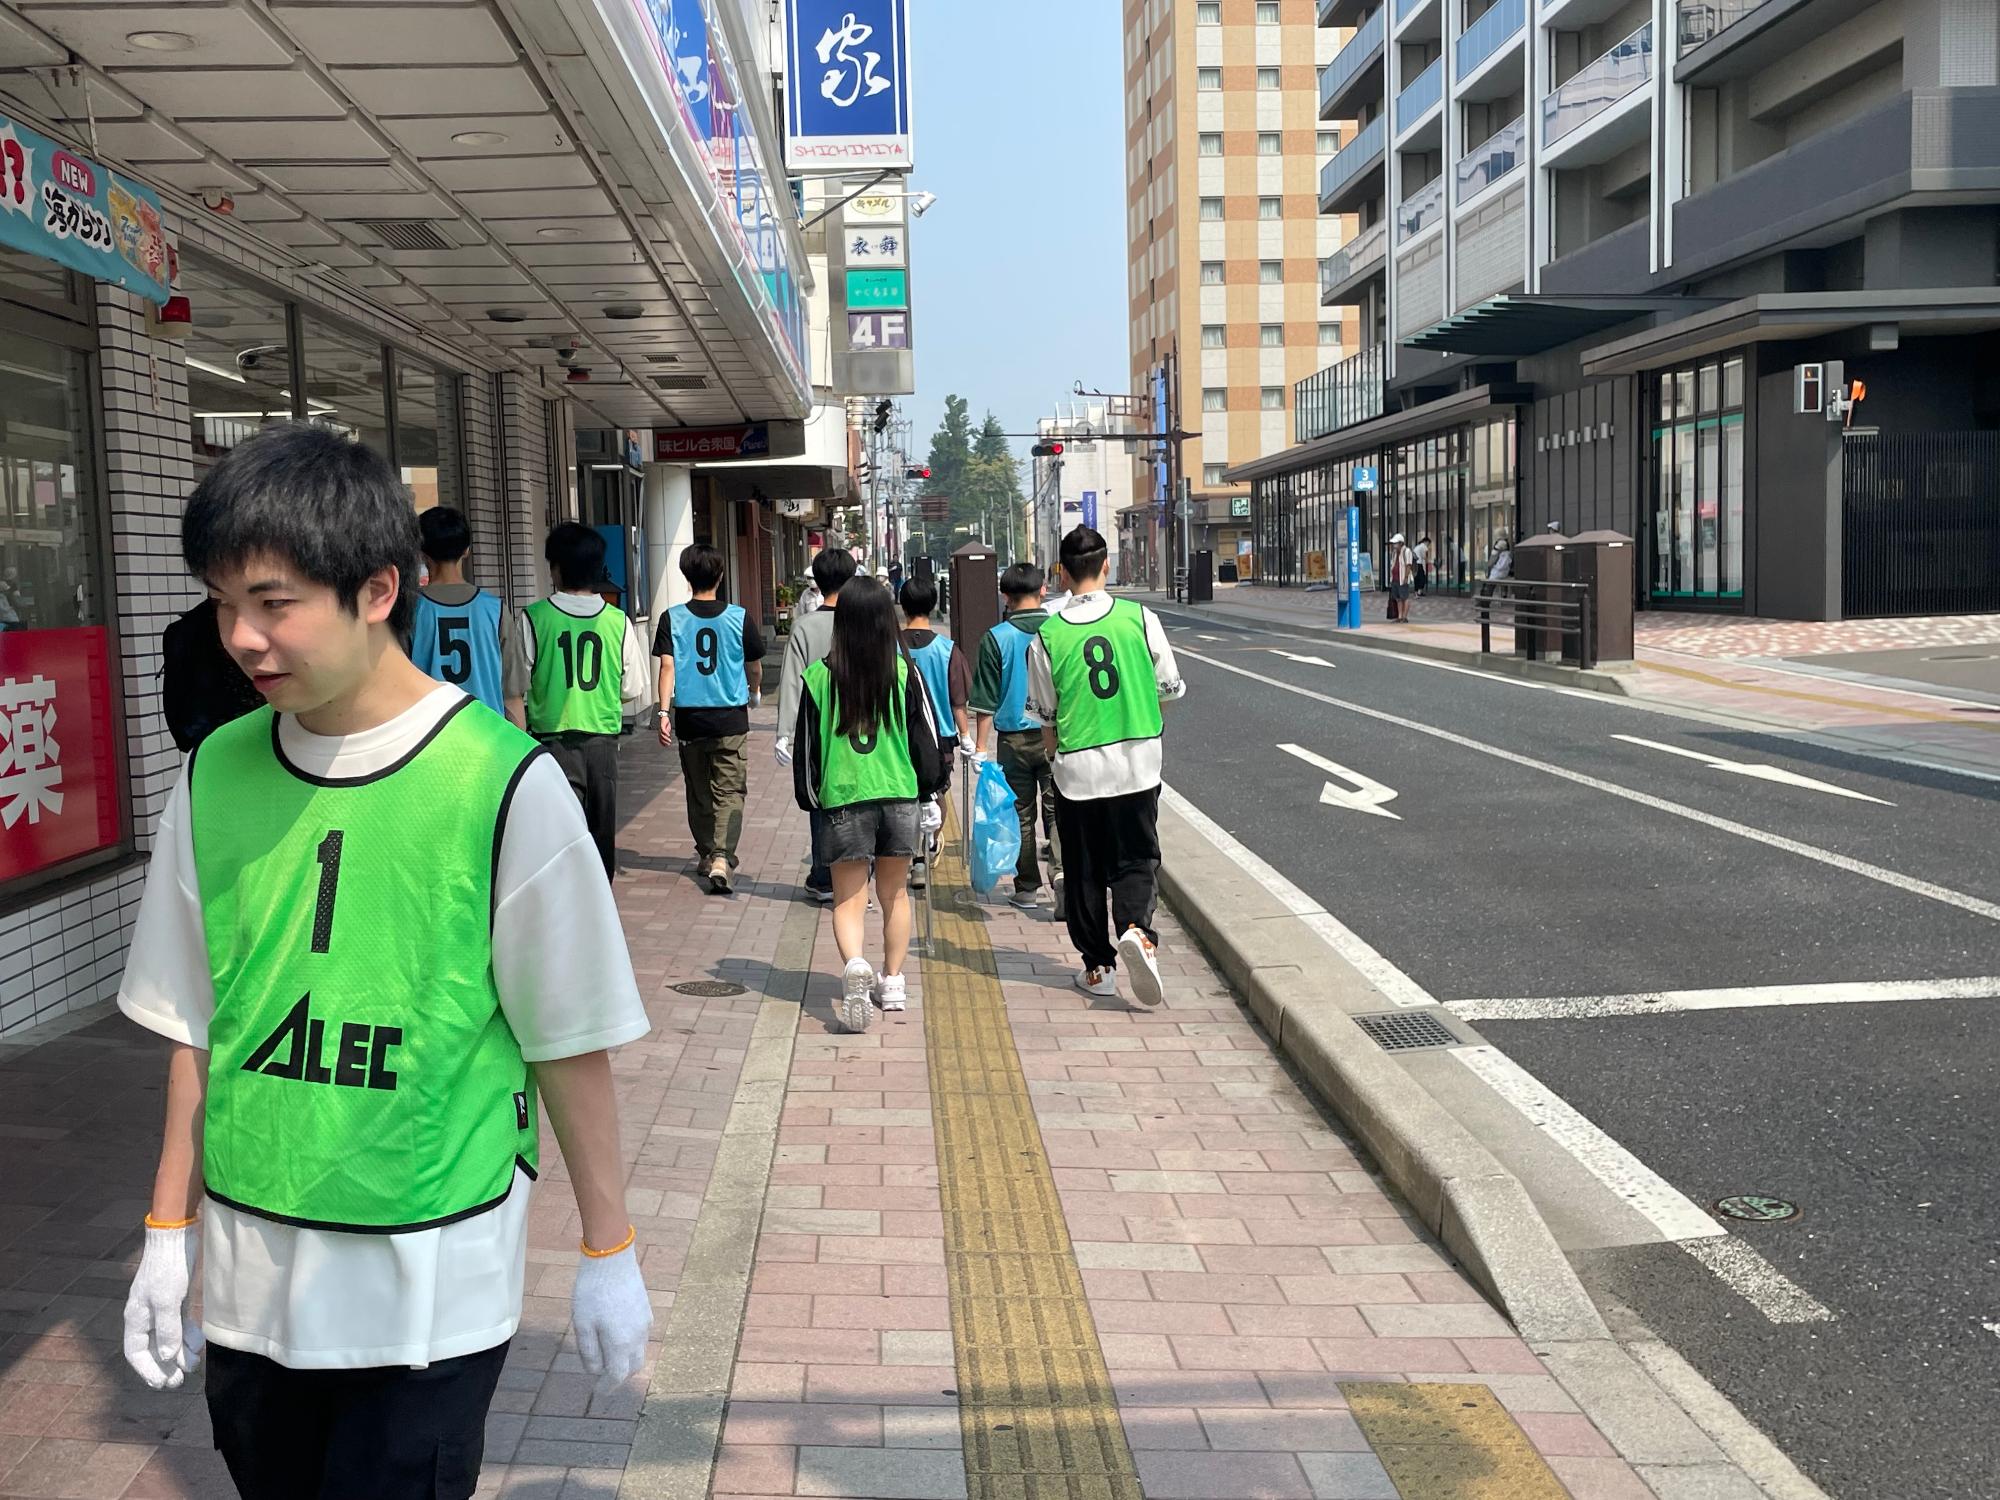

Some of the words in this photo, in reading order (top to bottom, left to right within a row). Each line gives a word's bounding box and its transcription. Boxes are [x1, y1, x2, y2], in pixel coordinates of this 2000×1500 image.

[61, 160, 88, 193] NEW
[795, 144, 904, 157] SHICHIMIYA
[852, 316, 904, 347] 4F
[1362, 469, 1369, 480] 3
[437, 617, 472, 684] 5
[557, 630, 603, 691] 10
[695, 628, 718, 676] 9
[1083, 636, 1119, 699] 8
[0, 674, 64, 830] 薬
[310, 830, 344, 953] 1
[240, 990, 403, 1090] ALEC
